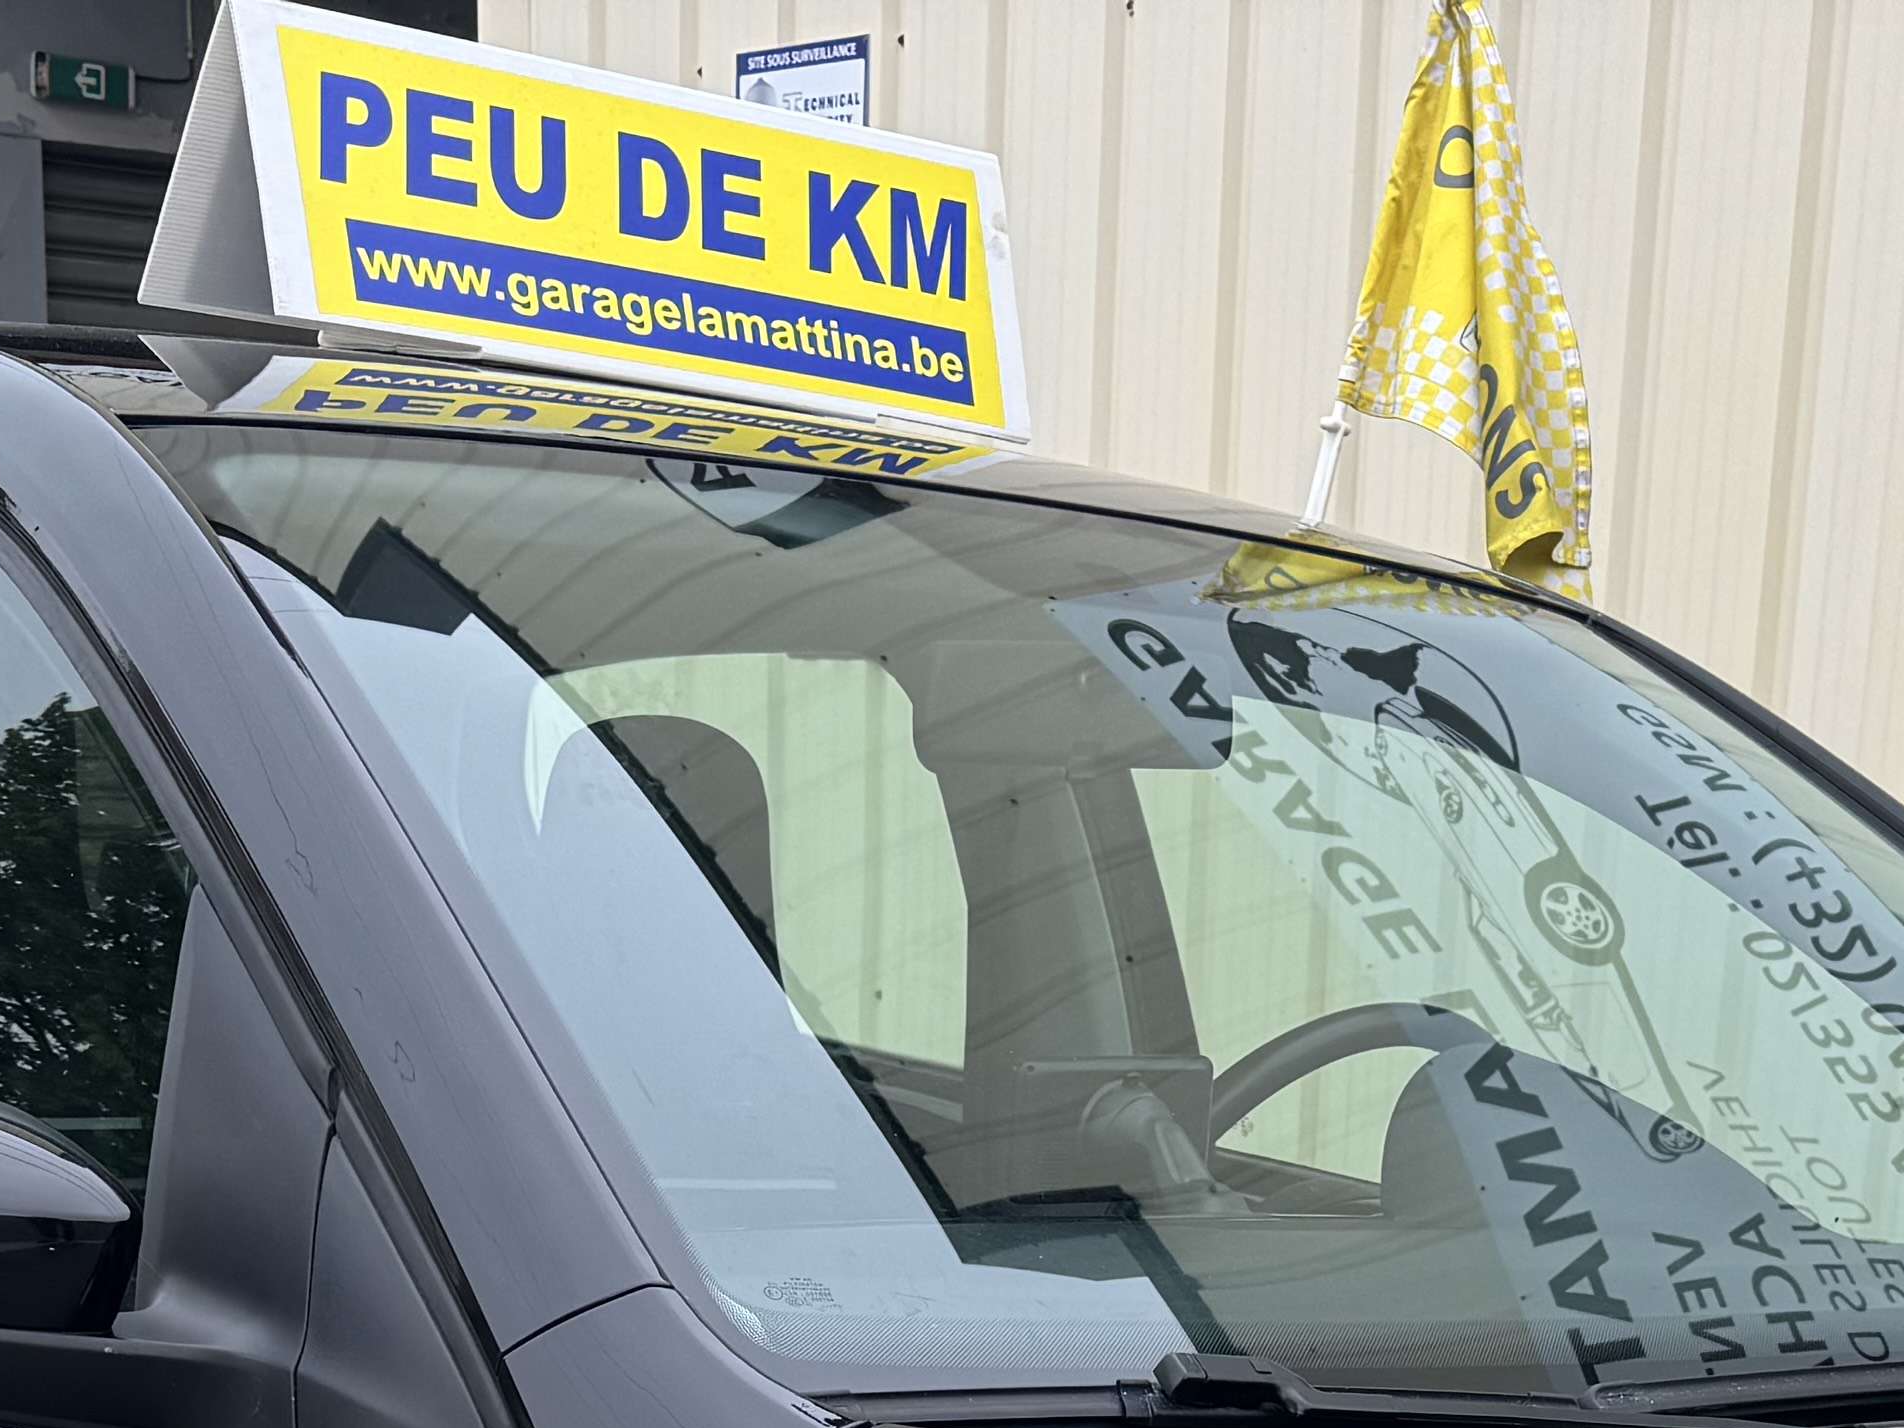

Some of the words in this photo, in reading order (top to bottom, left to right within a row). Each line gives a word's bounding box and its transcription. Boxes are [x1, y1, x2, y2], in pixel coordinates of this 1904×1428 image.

[748, 56, 765, 70] SITE
[767, 51, 790, 68] SOUS
[791, 42, 857, 65] SURVEILLANCE
[320, 72, 567, 220] PEU
[618, 131, 766, 262] DE
[809, 171, 968, 302] KM
[356, 246, 965, 384] www.garagelamattina.be
